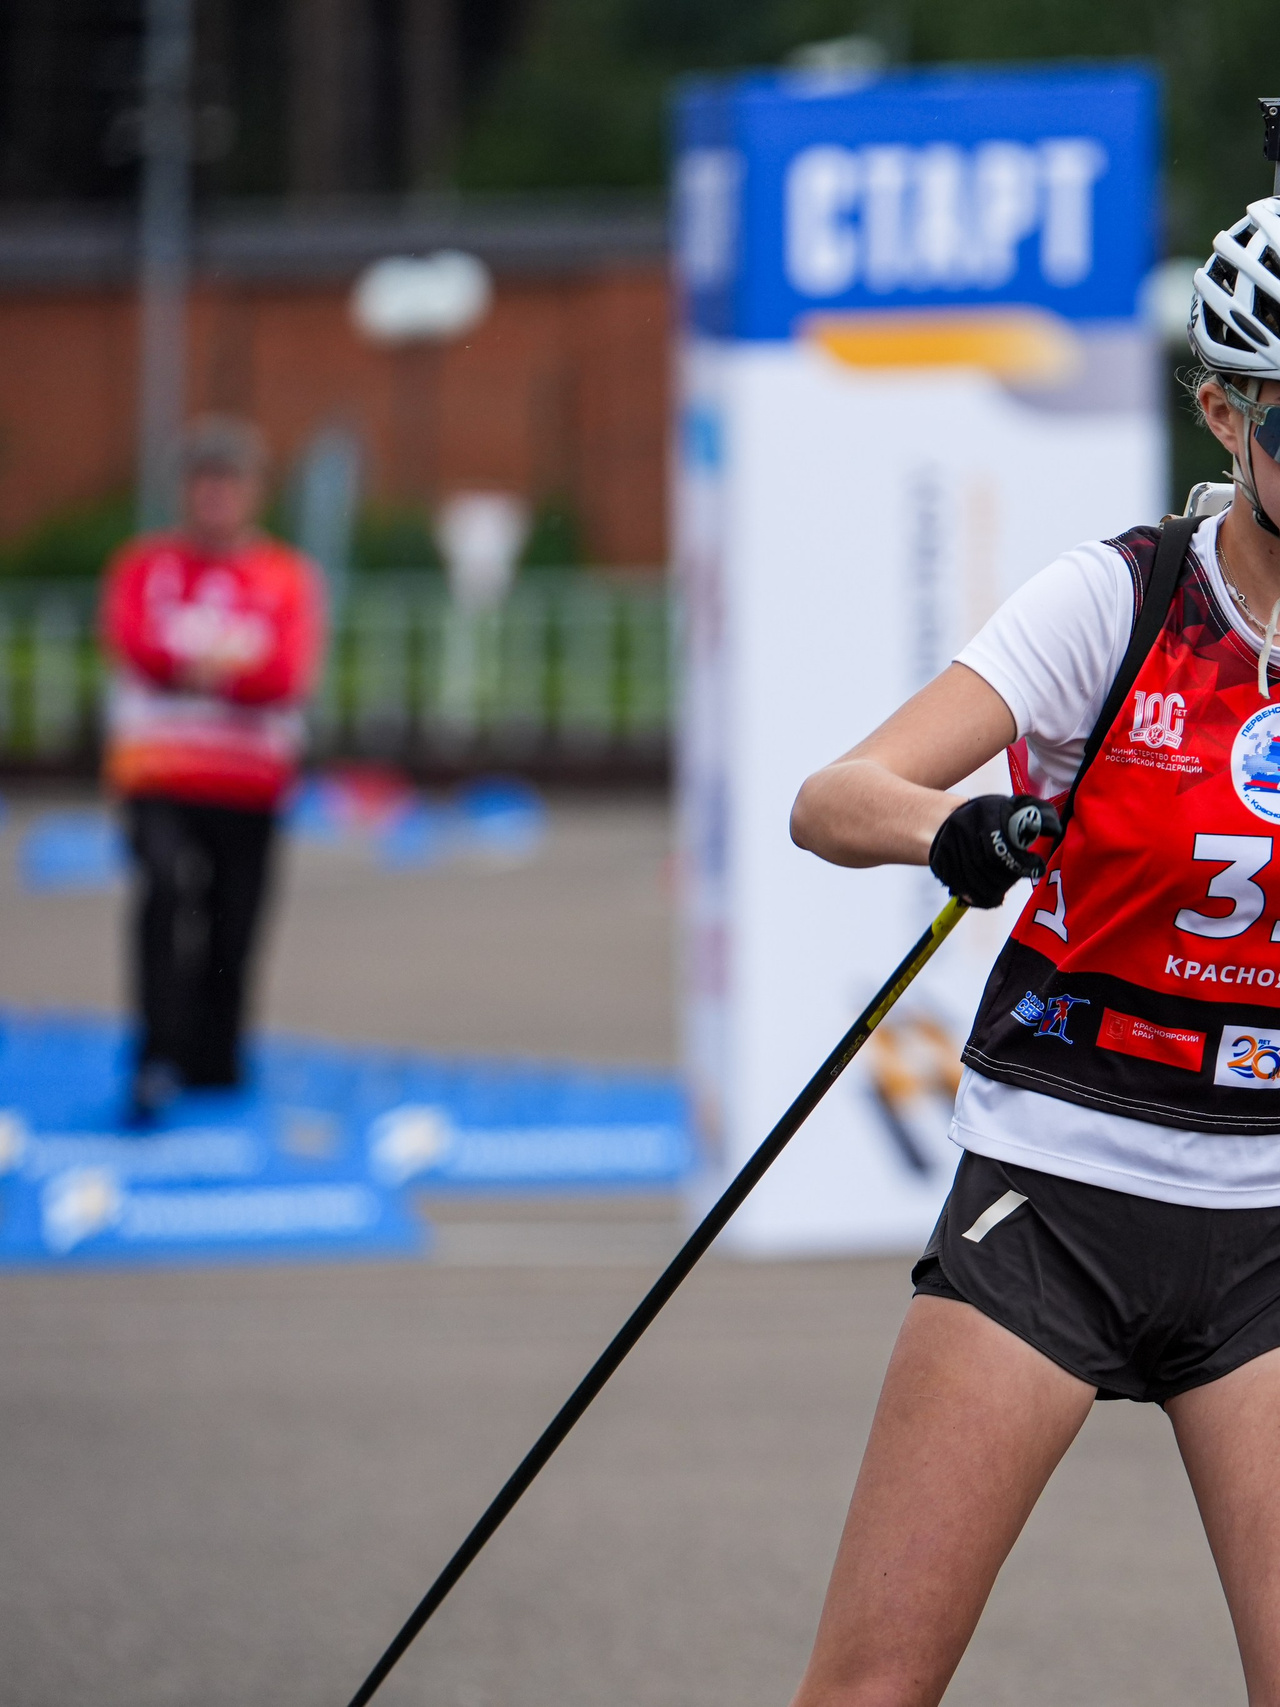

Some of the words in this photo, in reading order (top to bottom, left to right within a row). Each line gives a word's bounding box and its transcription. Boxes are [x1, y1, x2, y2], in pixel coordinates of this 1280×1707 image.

[786, 147, 1104, 296] СТАРТ
[1133, 690, 1185, 737] 100
[1173, 708, 1188, 717] ЛЕТ
[1105, 754, 1155, 767] РОССИЙСКОЙ
[1155, 761, 1203, 774] ФЕДЕРАЦИИ
[1111, 747, 1169, 761] МИНИСТЕРСТВО
[1170, 754, 1200, 764] СПОРТА
[1133, 1021, 1200, 1043] КРАСНОЯРСКИЙ
[1258, 1038, 1271, 1046] ЛЕТ
